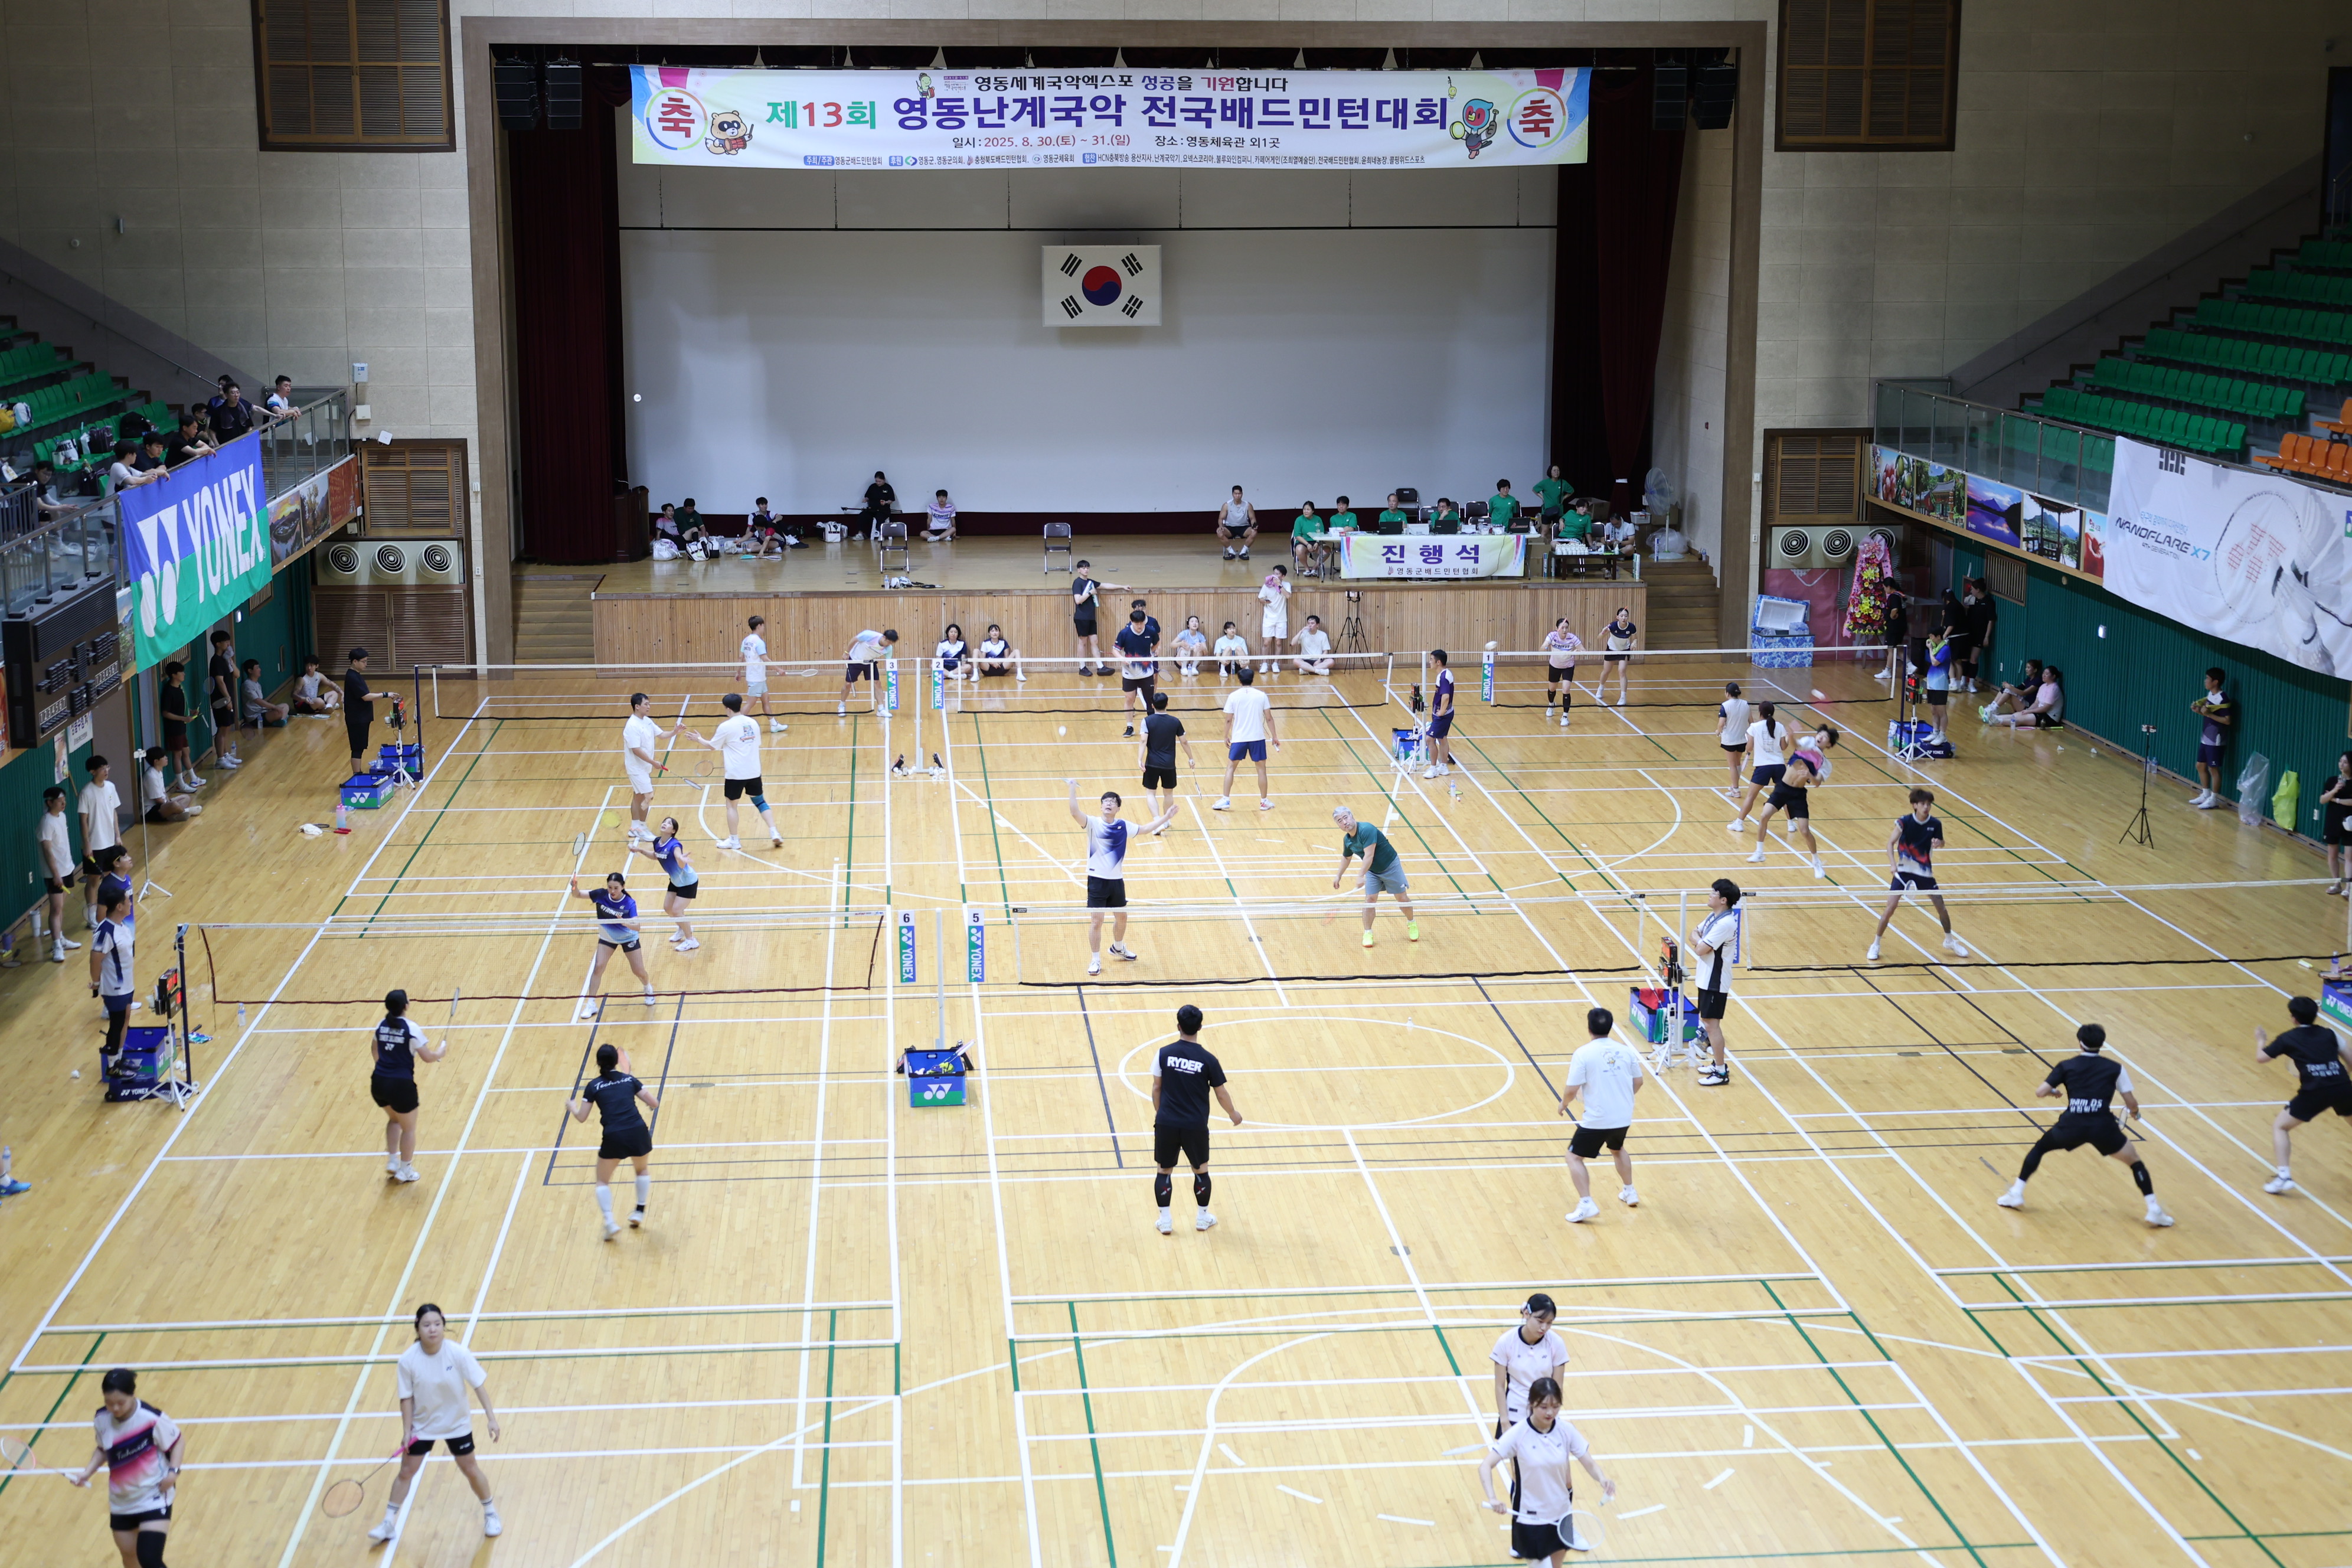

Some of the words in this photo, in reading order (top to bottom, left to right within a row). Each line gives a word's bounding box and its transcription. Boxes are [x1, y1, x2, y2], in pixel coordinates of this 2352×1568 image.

[974, 75, 1134, 92] 영동세계국악엑스포
[1142, 75, 1193, 92] 성공을
[1200, 76, 1289, 92] 기원합니다
[658, 97, 695, 138] 축
[765, 100, 876, 130] 제13회
[893, 96, 1127, 130] 영동난계국악
[1141, 96, 1448, 130] 전국배드민턴대회
[1518, 99, 1555, 138] 축
[1022, 136, 1033, 146] 8.
[1037, 135, 1076, 147] 30.(토)
[1091, 133, 1131, 147] 31.(일)
[1250, 136, 1280, 149] 외1곳
[806, 155, 833, 166] 주최/주관
[834, 155, 883, 166] 영동군배드민턴협회
[890, 156, 902, 165] 후원
[1043, 154, 1075, 164] 영동군체육회
[1084, 153, 1095, 163] 협찬
[1097, 153, 1130, 163] HCN충북방송
[181, 463, 264, 604] YONEX
[2115, 517, 2191, 553] NANOFLARE
[2191, 545, 2211, 561] X7
[1381, 545, 1405, 564] 진
[1419, 544, 1443, 565] 행
[1455, 544, 1479, 564] 석
[1396, 567, 1478, 576] 영동군배드민턴협회
[888, 685, 897, 708] YONEX
[934, 685, 942, 707] YONEX
[1482, 677, 1491, 700] YONEX
[903, 913, 910, 923] 6
[972, 913, 979, 923] 5
[901, 947, 914, 979] YONEX
[971, 947, 982, 979] YONEX
[1167, 1056, 1203, 1073] RYDER
